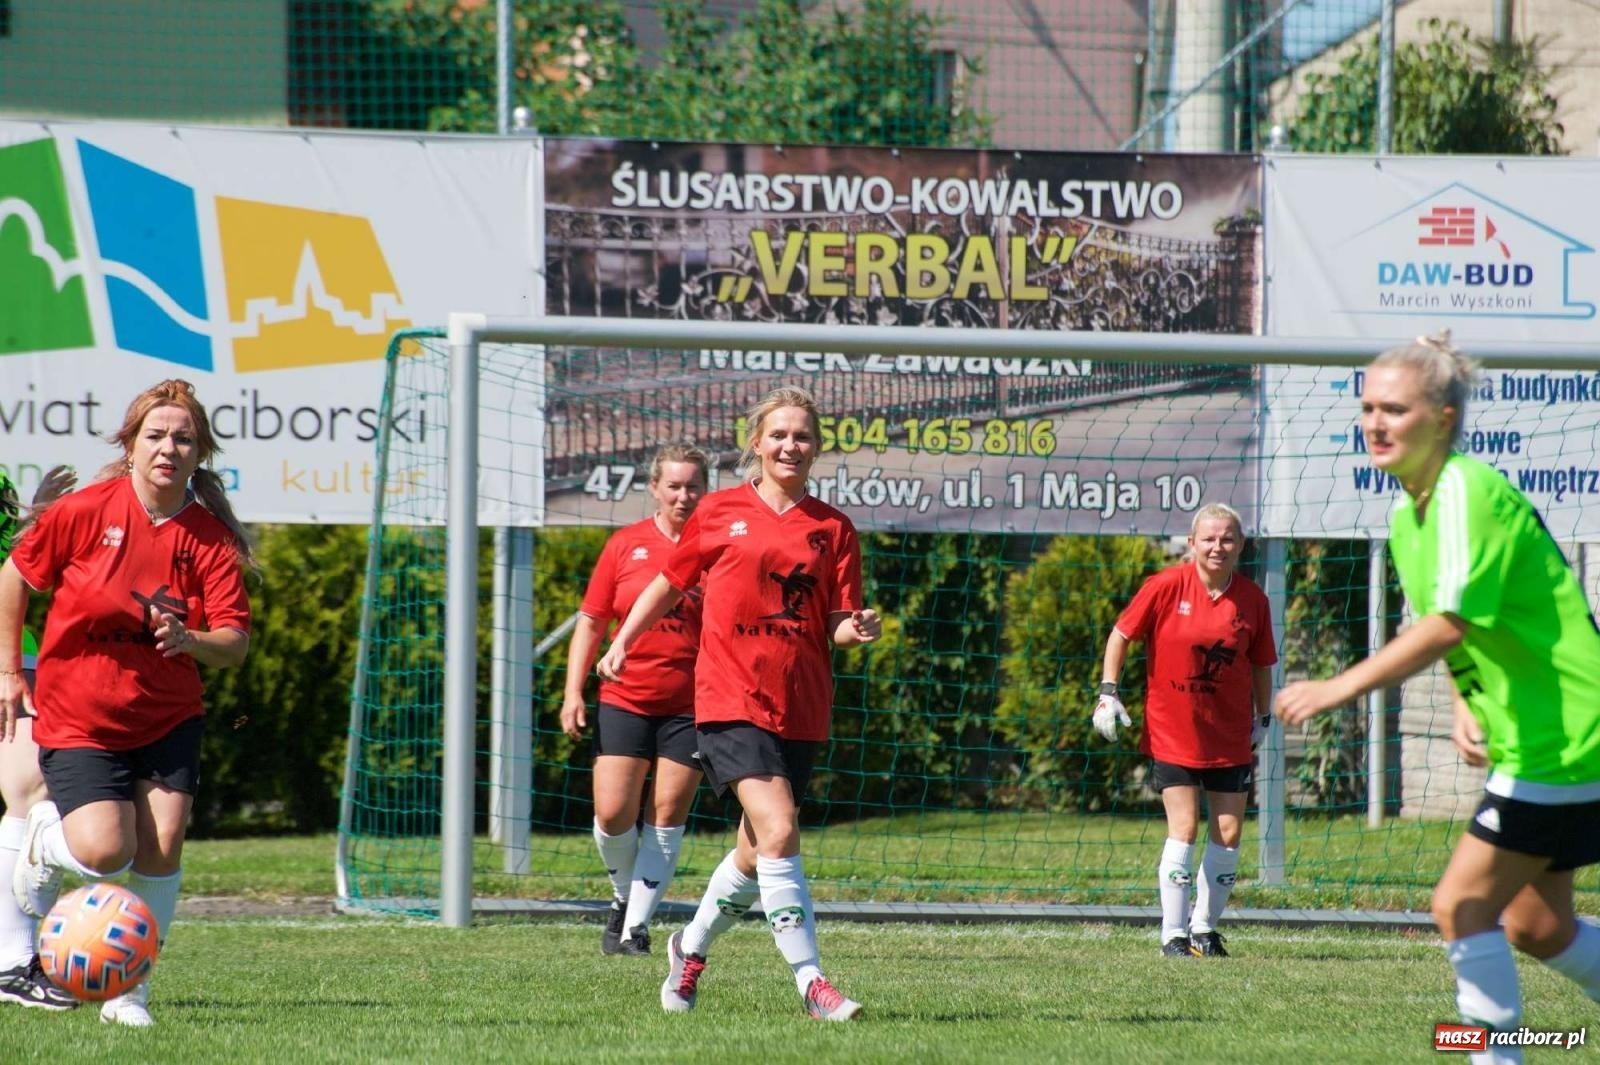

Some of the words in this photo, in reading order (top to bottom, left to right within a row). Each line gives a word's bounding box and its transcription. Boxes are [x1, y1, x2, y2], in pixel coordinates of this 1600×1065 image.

[611, 161, 1184, 220] ŚLUSARSTWO-KOWALSTWO
[1378, 262, 1534, 287] DAW-BUD
[1379, 293, 1440, 308] Marcin
[1450, 293, 1533, 312] Wyszkoni
[211, 388, 427, 444] ciborski
[903, 417, 973, 455] 165
[983, 419, 1057, 457] 816
[943, 469, 995, 508] ul.
[1007, 473, 1026, 508] 1
[1042, 473, 1141, 519] Maja
[1154, 475, 1202, 511] 10
[1518, 466, 1600, 502] wnętrz
